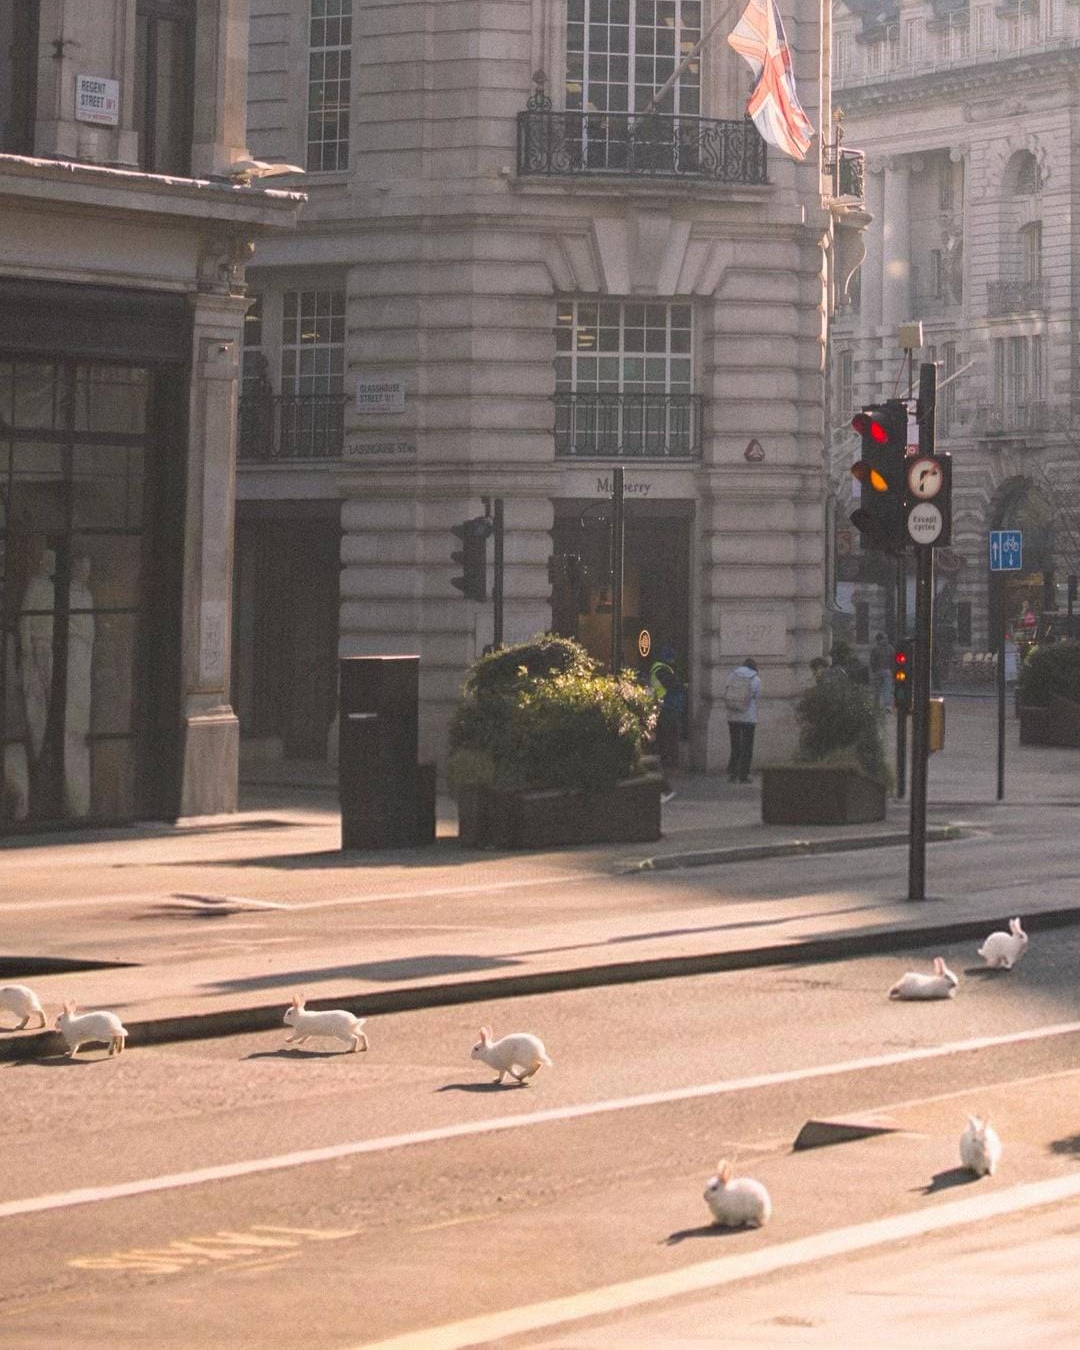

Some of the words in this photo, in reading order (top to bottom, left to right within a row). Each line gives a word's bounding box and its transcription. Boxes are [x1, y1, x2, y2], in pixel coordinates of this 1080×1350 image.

[81, 80, 106, 95] REGENT
[80, 94, 105, 108] STREET
[360, 383, 400, 394] GLASSHOUSE
[360, 394, 383, 403] STREET
[913, 515, 937, 524] Except
[914, 523, 936, 532] cycles
